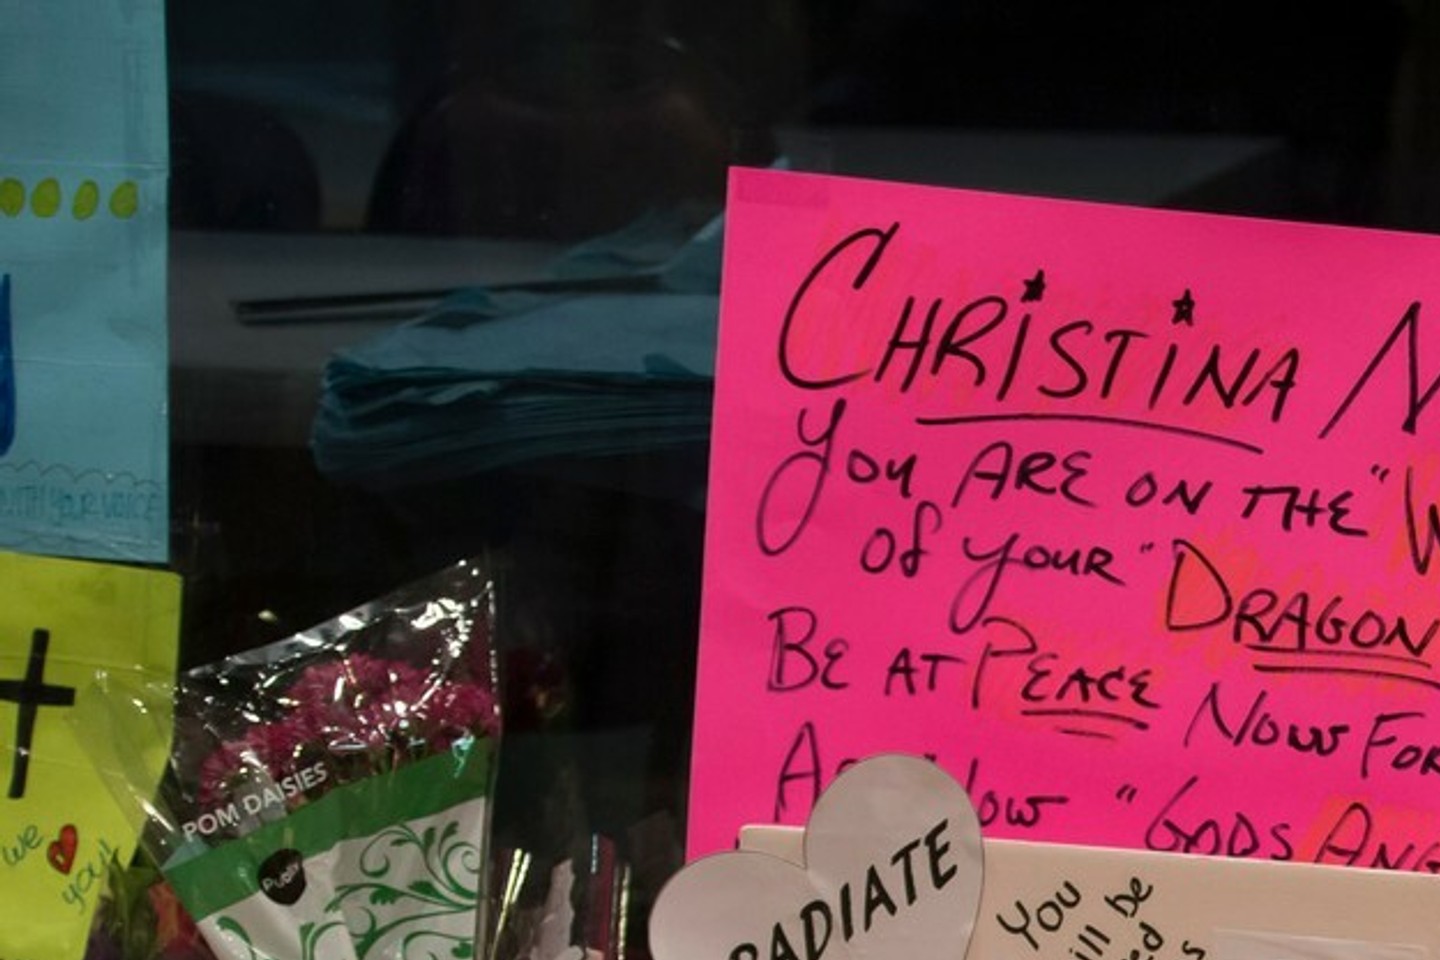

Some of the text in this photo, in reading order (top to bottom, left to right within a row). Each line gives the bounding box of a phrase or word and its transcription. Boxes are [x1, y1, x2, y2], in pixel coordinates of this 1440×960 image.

[952, 441, 1098, 508] ARE
[1125, 472, 1212, 515] ON
[1241, 485, 1369, 538] THE
[885, 648, 969, 697] AT
[971, 617, 1162, 710] PEACE
[182, 761, 329, 842] POM DAISIES
[3, 824, 45, 868] we
[996, 880, 1083, 951] You
[1104, 877, 1153, 918] be
